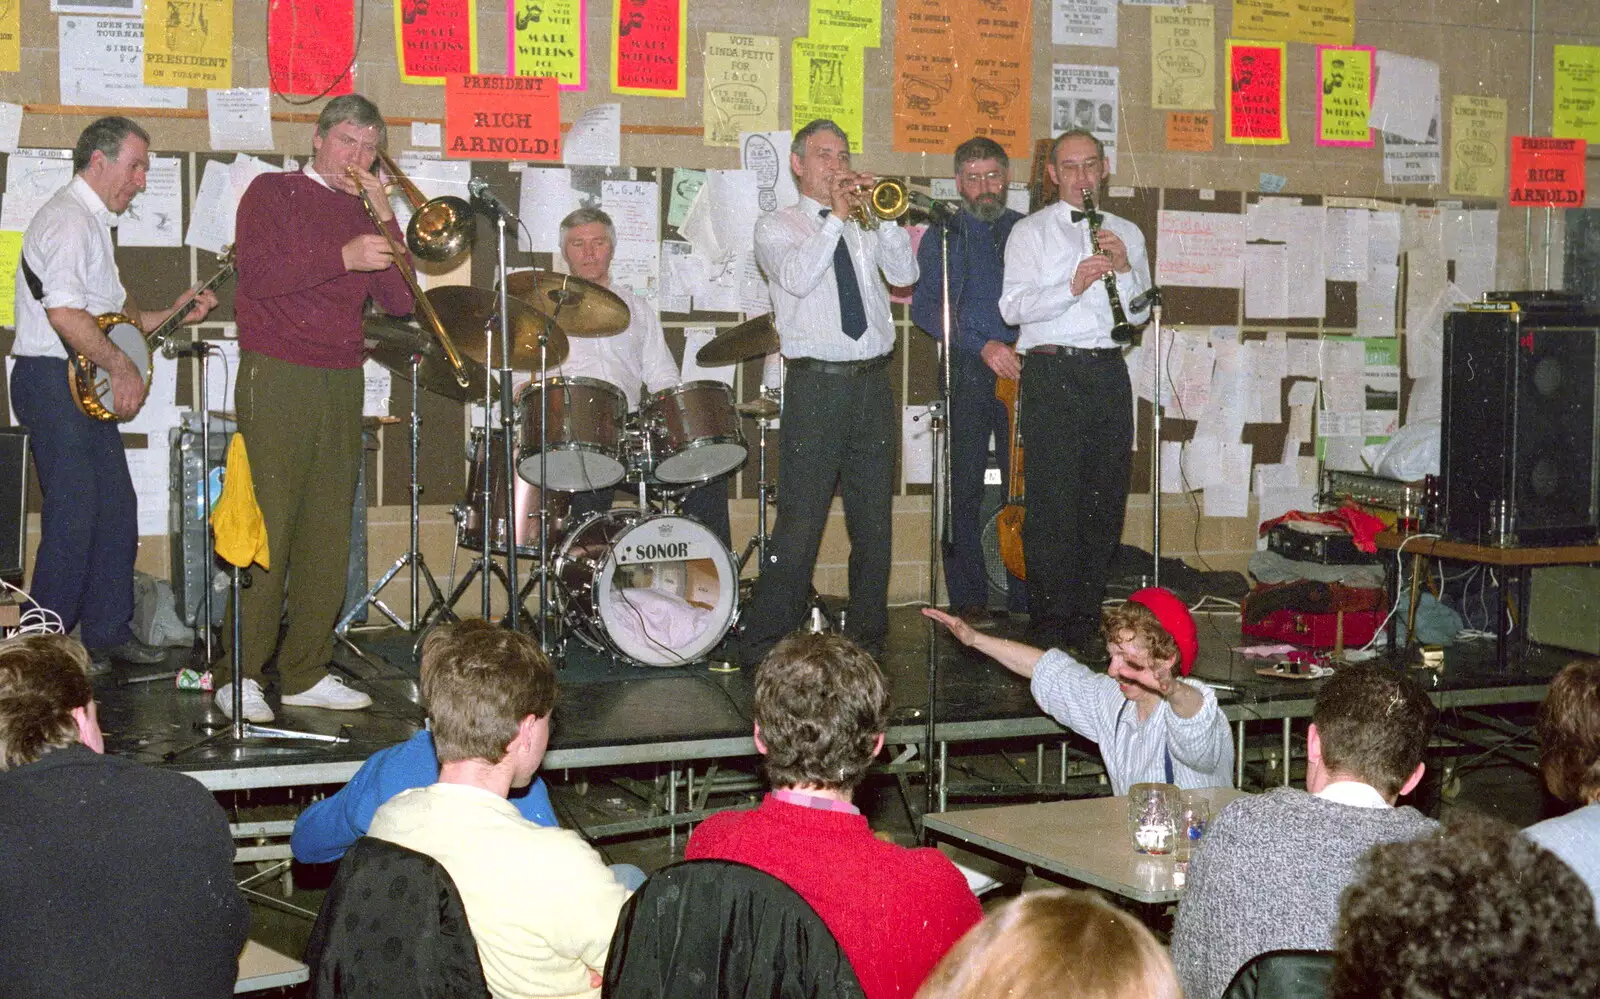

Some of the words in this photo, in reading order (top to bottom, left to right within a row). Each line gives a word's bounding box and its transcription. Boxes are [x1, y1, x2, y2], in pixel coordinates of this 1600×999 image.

[548, 16, 570, 25] VOTE
[730, 36, 755, 46] VOTE
[709, 47, 738, 58] LINDA
[146, 53, 228, 68] PRESIDENT
[731, 61, 750, 71] FOR
[1054, 69, 1109, 77] WHICHEVER
[462, 76, 543, 91] PRESIDENT
[474, 112, 532, 129] RICH
[452, 136, 559, 155] ARNOLD!
[1521, 138, 1576, 150] PRESIDENT
[1528, 169, 1566, 183] RICH
[1511, 188, 1584, 202] ARNOLD!
[636, 543, 688, 560] SONOR
